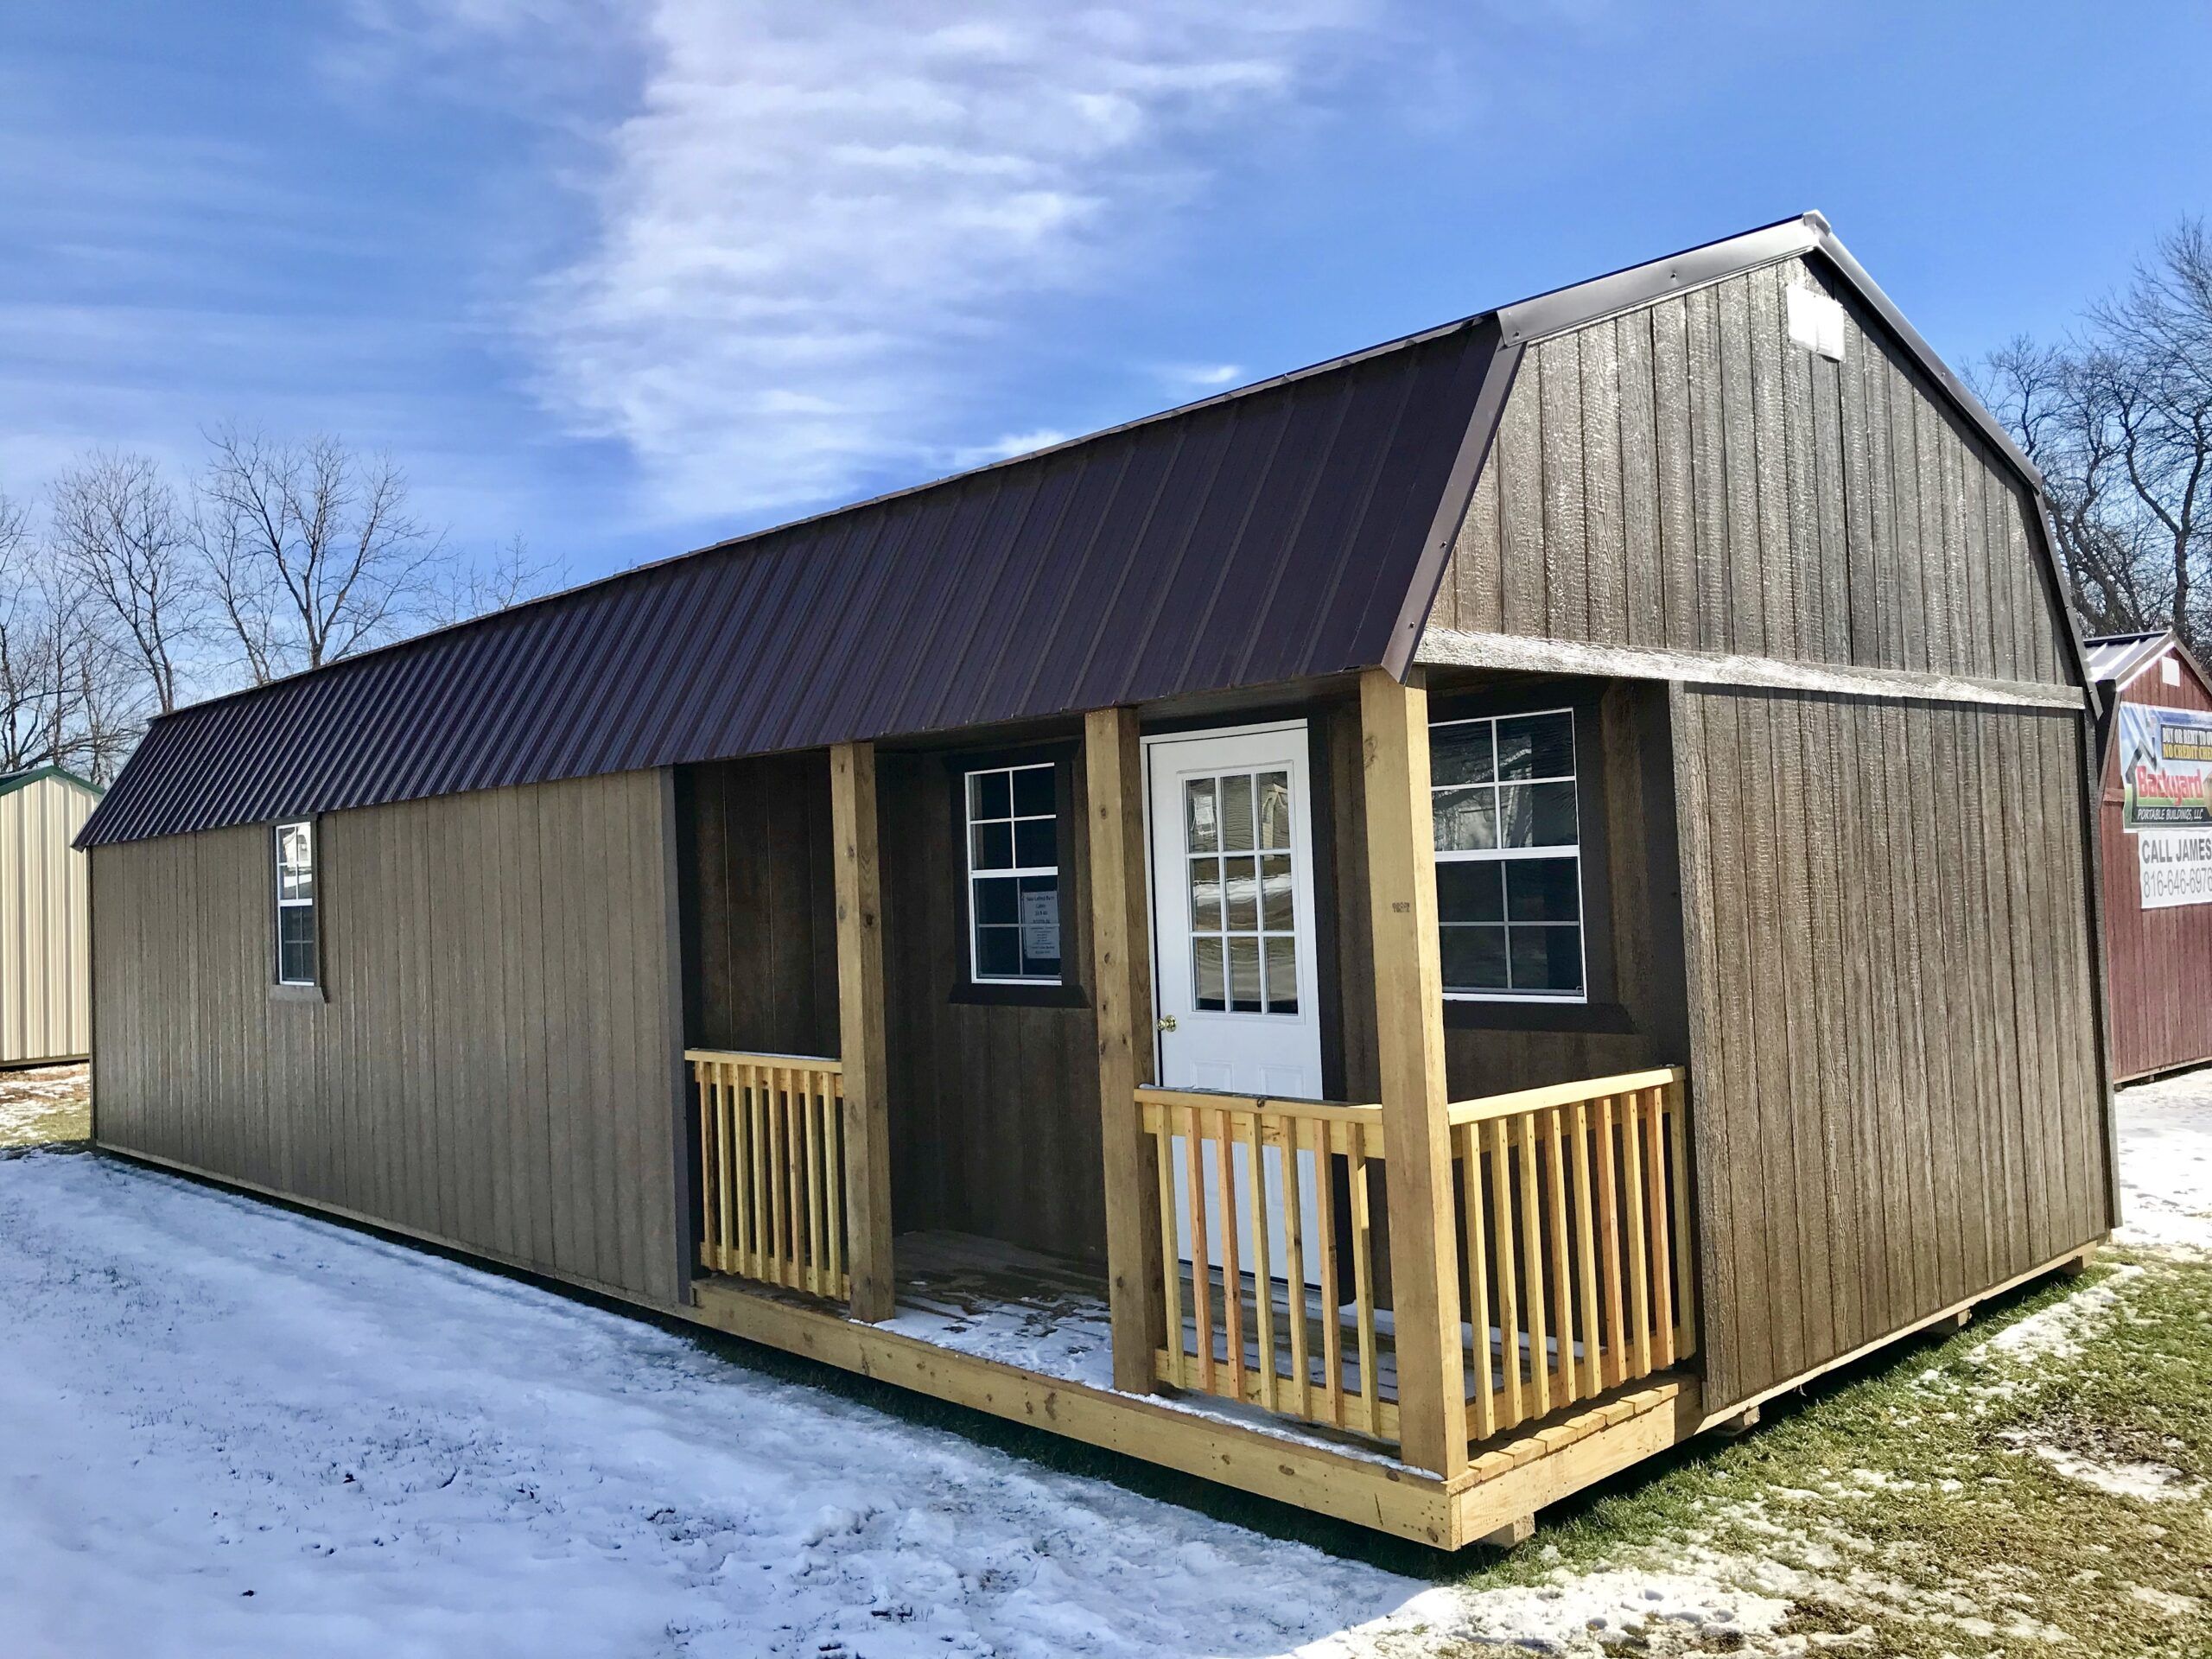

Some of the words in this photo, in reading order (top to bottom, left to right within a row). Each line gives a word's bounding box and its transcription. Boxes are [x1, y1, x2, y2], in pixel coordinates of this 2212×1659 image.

[2174, 728, 2183, 744] OR
[2183, 729, 2198, 745] RENT
[2199, 730, 2206, 746] TO
[2164, 743, 2173, 758] NO
[2174, 744, 2198, 760] CREDIT
[2136, 765, 2203, 806] Backyard
[2138, 808, 2165, 820] PORTABLE
[2165, 808, 2193, 821] BUILDINGS,
[2194, 808, 2203, 820] LLC
[2142, 840, 2172, 864] CALL
[2176, 838, 2212, 862] JAMES
